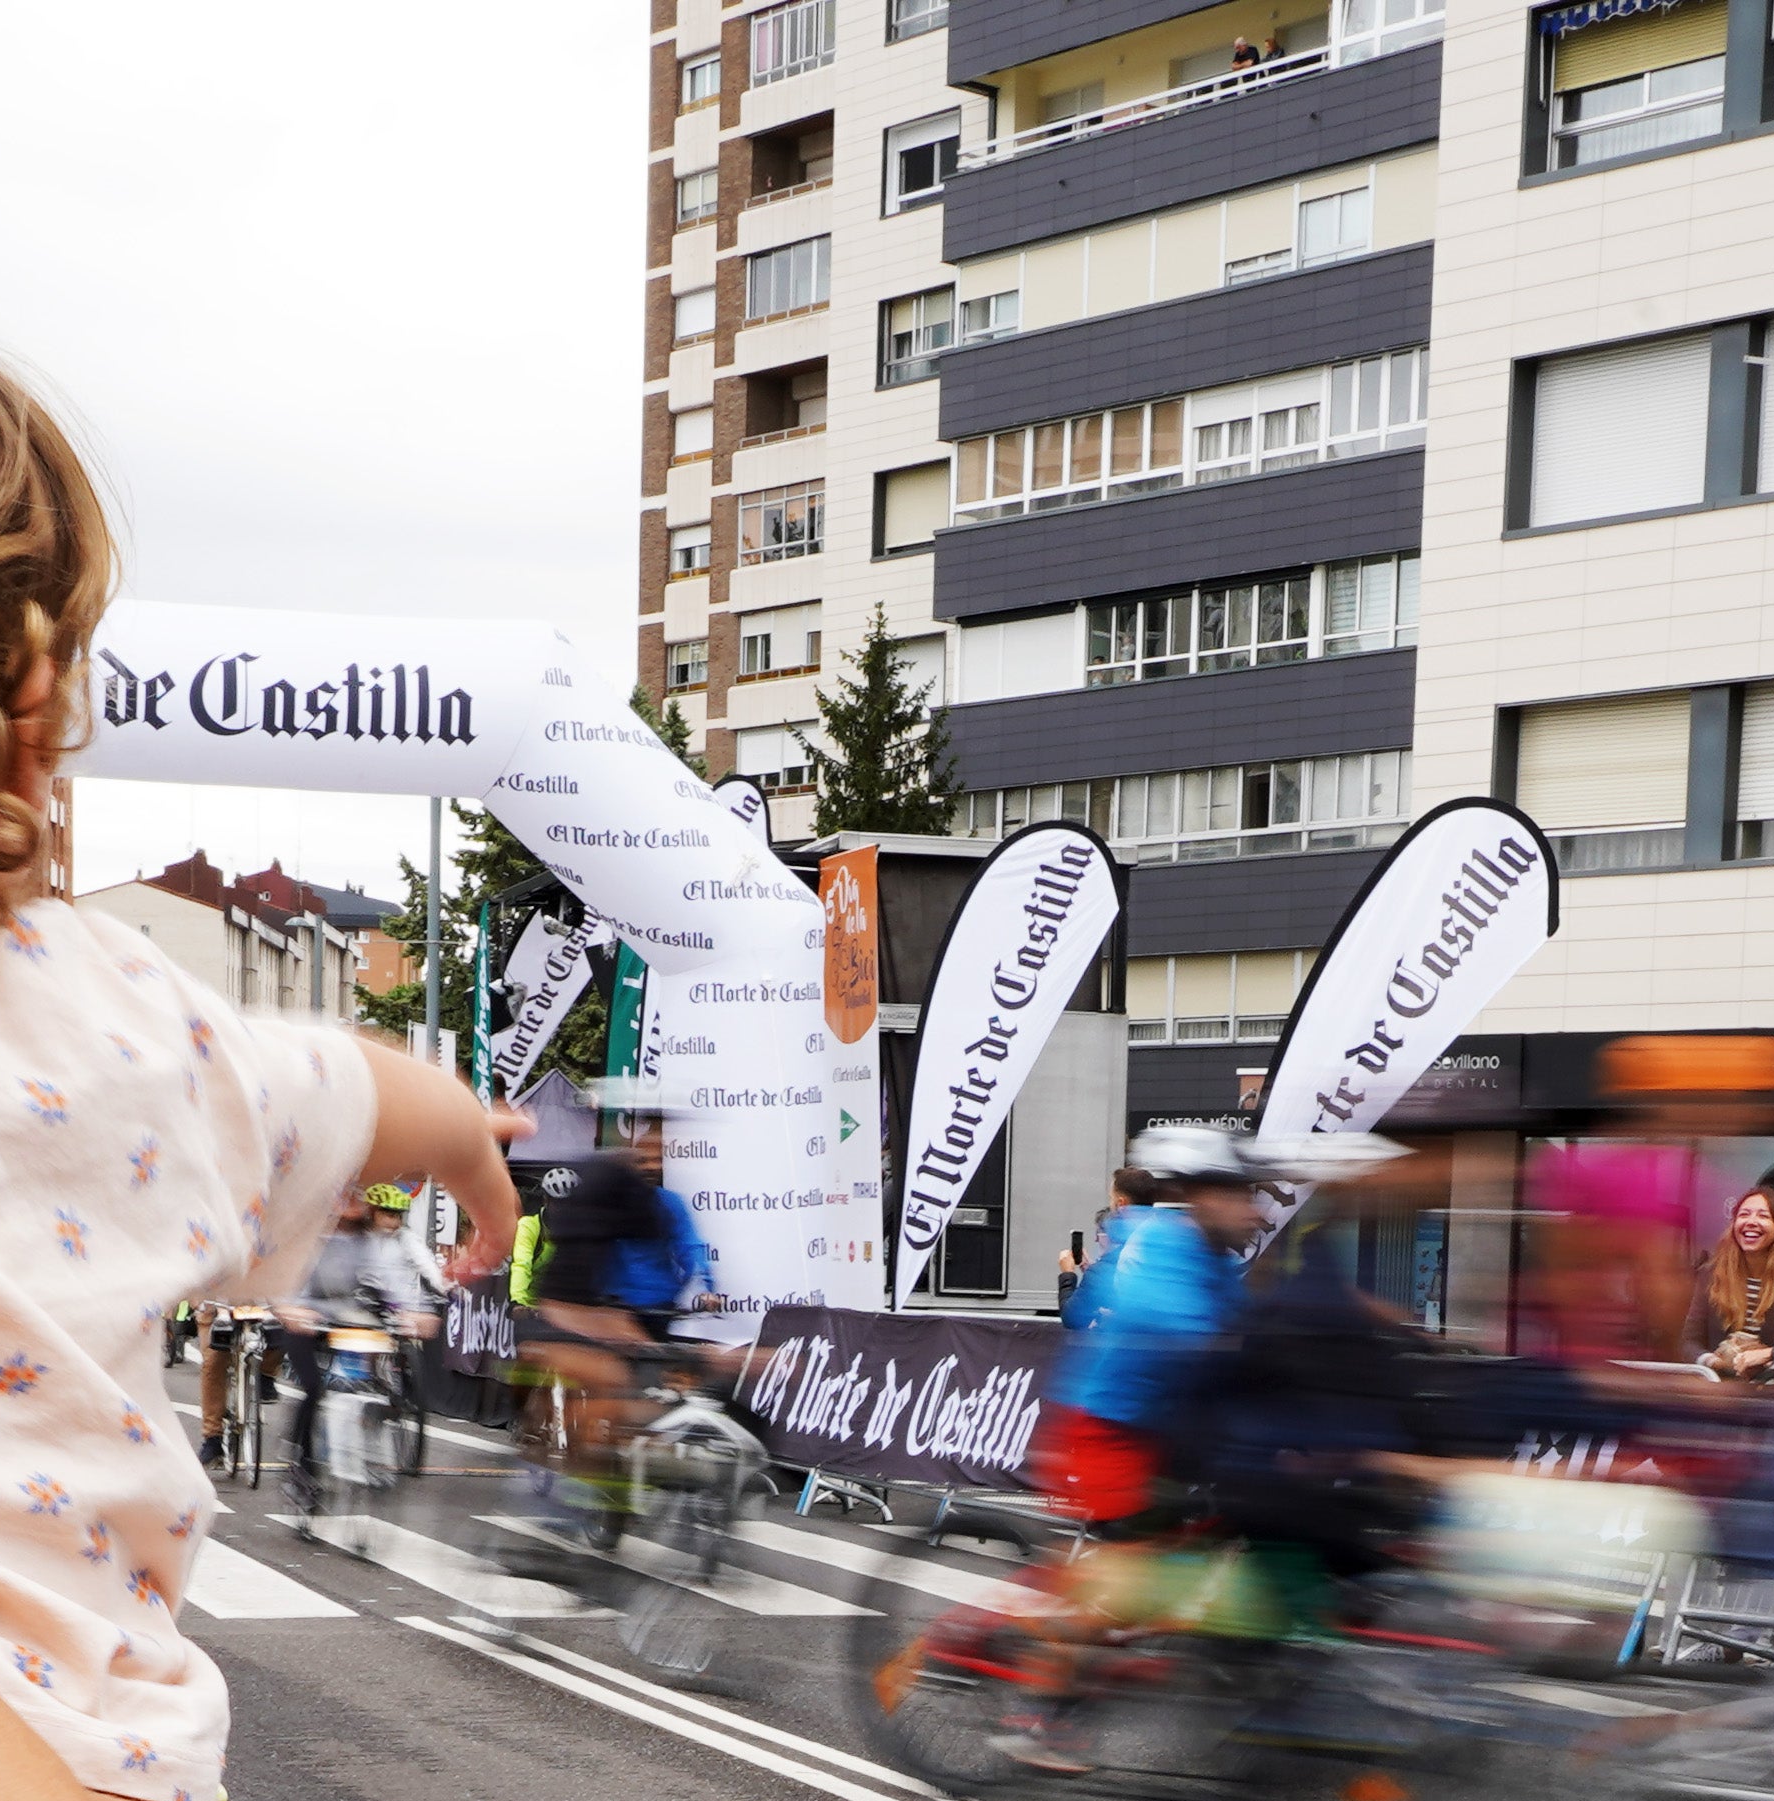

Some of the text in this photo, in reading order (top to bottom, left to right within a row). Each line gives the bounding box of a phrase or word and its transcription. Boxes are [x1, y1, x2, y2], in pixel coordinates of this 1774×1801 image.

[97, 647, 478, 746] de Castilla
[545, 721, 567, 742] El
[571, 721, 614, 742] Norte
[508, 773, 579, 795] Castilla
[547, 825, 710, 849] El Norte de Castilla
[683, 881, 706, 900] El
[755, 882, 771, 901] de
[627, 924, 647, 942] de
[647, 927, 714, 950] Castilla
[1345, 1018, 1405, 1075] de
[1386, 836, 1538, 1019] Castilla
[526, 982, 560, 1011] de
[688, 983, 709, 1003] El
[711, 982, 757, 1003] Norte
[760, 983, 777, 1003] de
[667, 1036, 717, 1056] Castilla
[903, 842, 1096, 1252] El Norte de Castilla
[1434, 1077, 1499, 1088] DENTAL
[690, 1087, 710, 1108] El
[712, 1087, 758, 1108] Norte
[762, 1089, 777, 1108] de
[1209, 1113, 1252, 1131] MÉDIC
[667, 1139, 718, 1159] Castilla
[692, 1191, 712, 1211] El
[714, 1191, 760, 1211] Norte
[762, 1192, 779, 1211] de
[750, 1334, 1041, 1472] El Norte de Castilla
